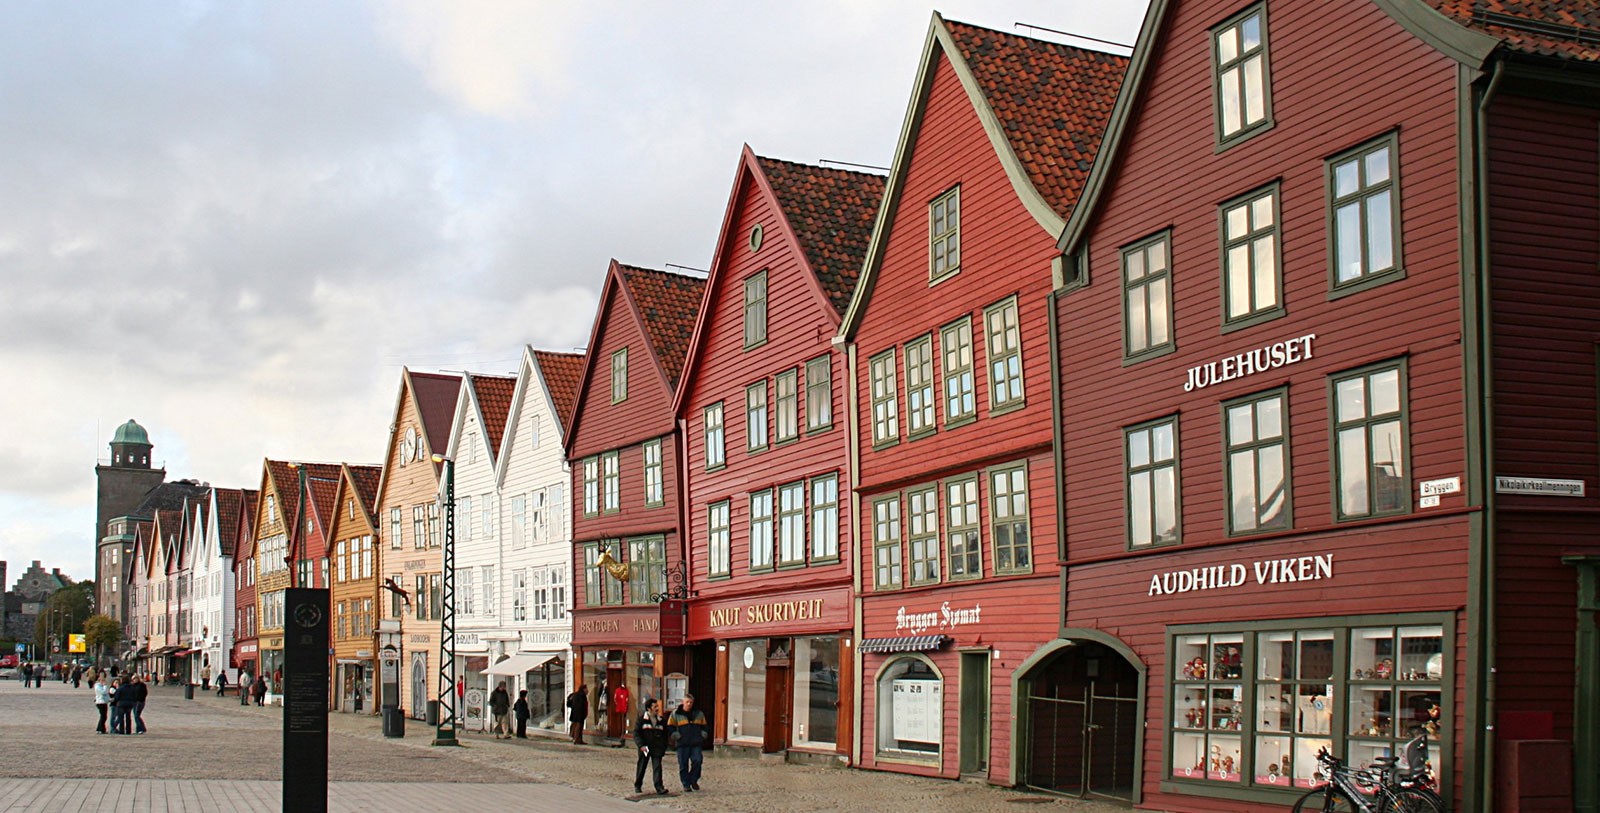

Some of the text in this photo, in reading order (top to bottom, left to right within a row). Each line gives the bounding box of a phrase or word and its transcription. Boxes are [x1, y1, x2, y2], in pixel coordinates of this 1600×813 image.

[1184, 333, 1316, 392] JULEHUSET
[1424, 481, 1454, 493] Bryggen
[1148, 553, 1333, 596] AUDHILD VIKEN
[580, 619, 619, 632] BRYGGEN
[710, 598, 823, 627] KNUT SKURTVEIT
[896, 606, 938, 636] Bryggen
